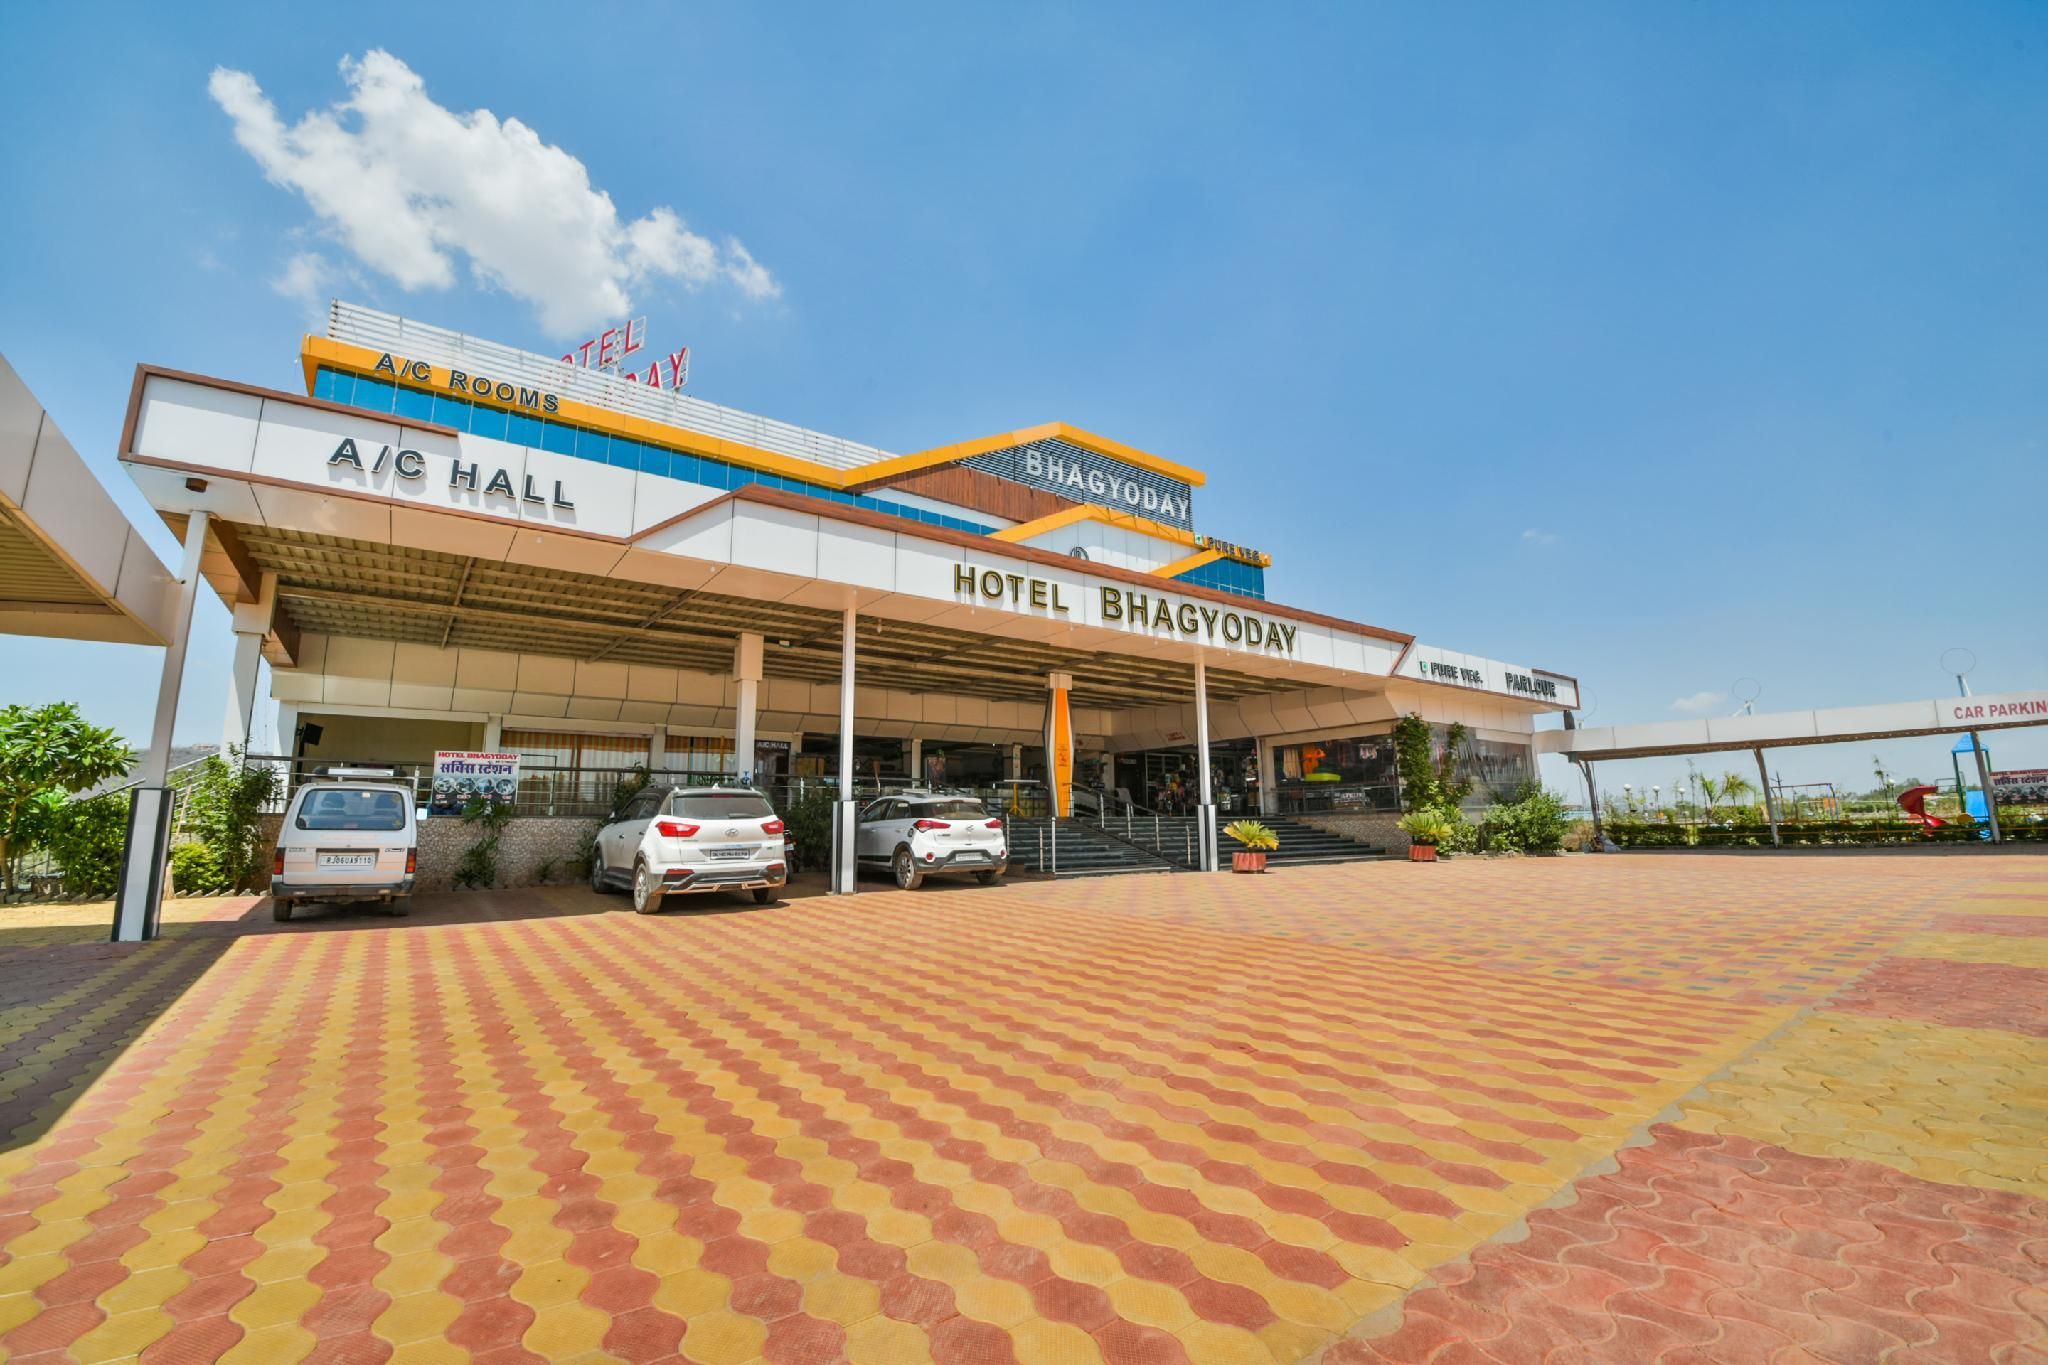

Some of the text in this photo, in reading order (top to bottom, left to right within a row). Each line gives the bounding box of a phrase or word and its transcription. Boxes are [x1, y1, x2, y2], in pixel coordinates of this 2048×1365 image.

[374, 352, 560, 414] A/C ROOMS
[327, 437, 575, 509] A/C HALL
[1025, 449, 1191, 521] BHAGYODAY
[1207, 536, 1235, 555] PURE
[953, 563, 1297, 652] HOTEL BHAGYODAY
[1431, 661, 1484, 684] PURE VEG.
[1504, 671, 1557, 698] PARLOUR
[1953, 699, 2048, 720] CAR PARKIN
[467, 752, 518, 760] BHAGYODAY
